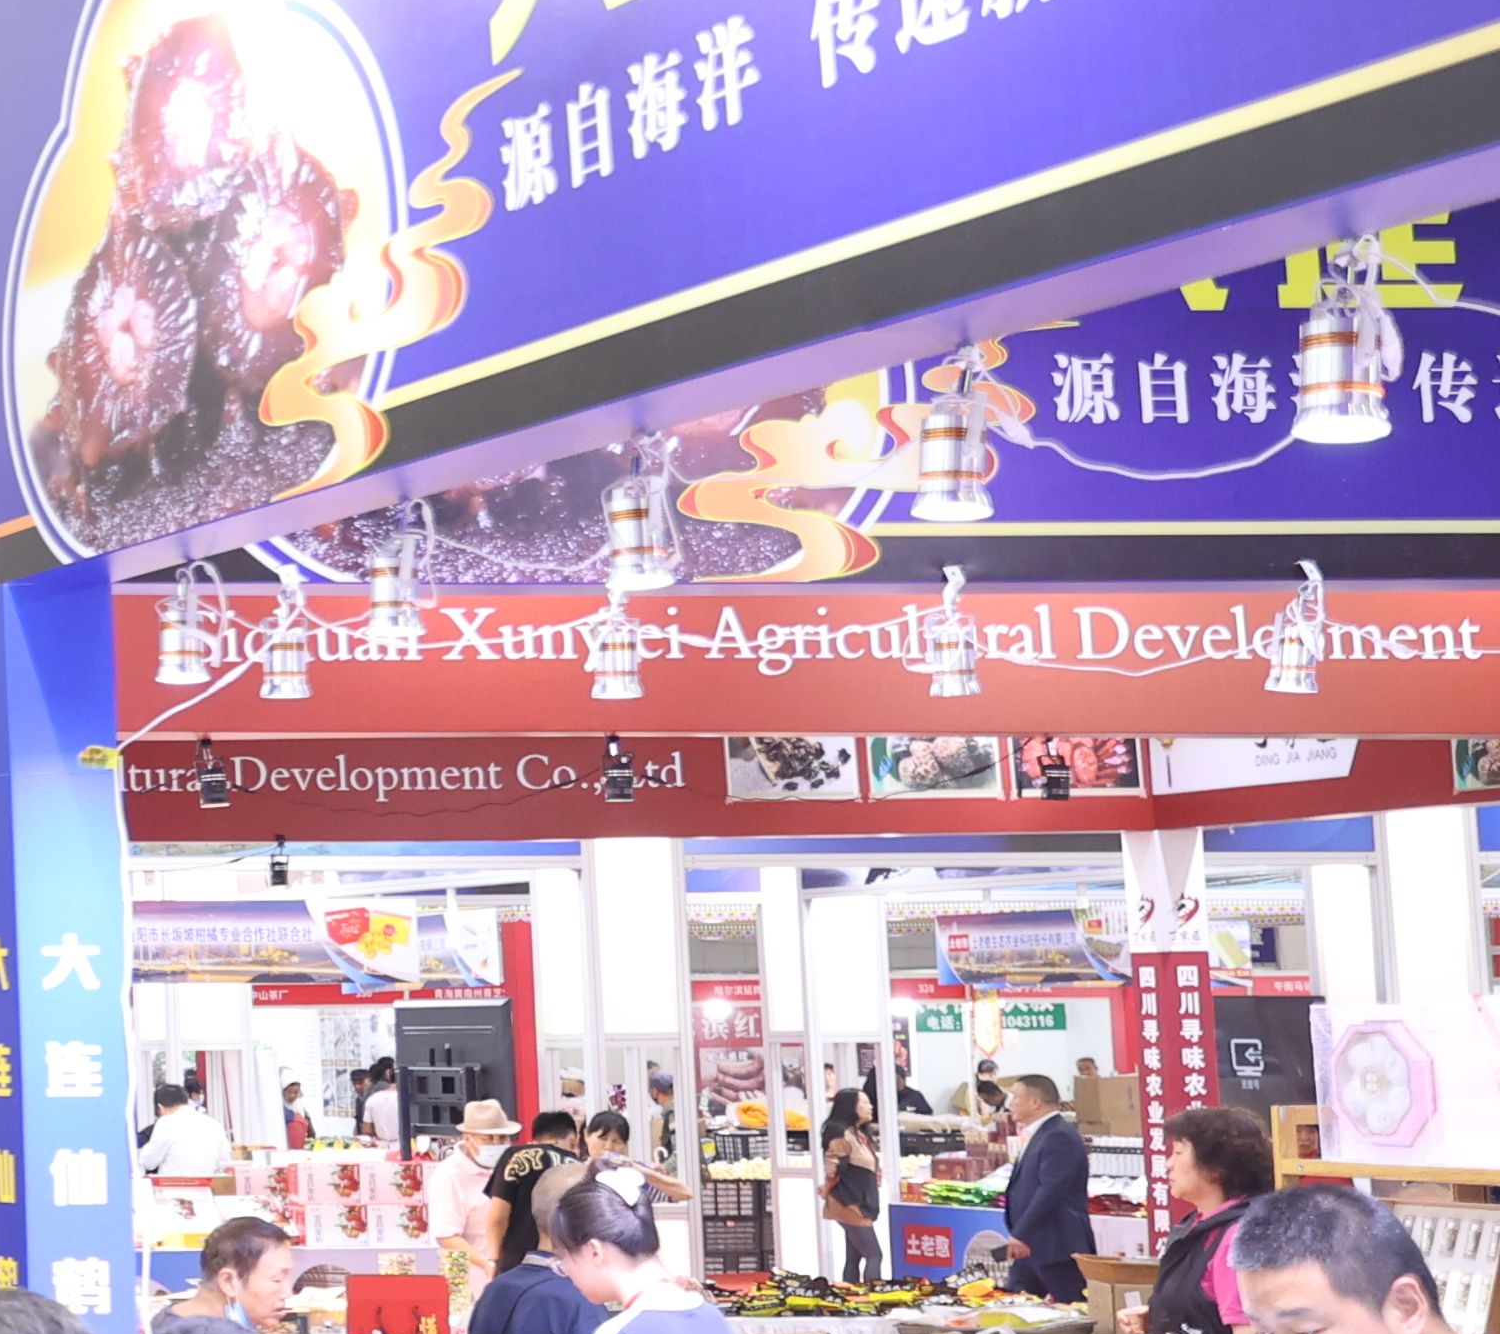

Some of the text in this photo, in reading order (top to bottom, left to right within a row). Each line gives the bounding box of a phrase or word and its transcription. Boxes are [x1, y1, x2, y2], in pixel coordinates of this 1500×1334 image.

[499, 13, 761, 211] 源自海洋
[1412, 353, 1500, 424] 传
[195, 605, 424, 663] Sicuan
[705, 604, 1056, 677] Agriculral
[1076, 604, 1482, 663] Develoment
[234, 754, 503, 803] Development
[1254, 747, 1337, 767] DING JIA JIANG
[132, 926, 313, 943] 阳市长坂坡柑橘专业合作社联合社
